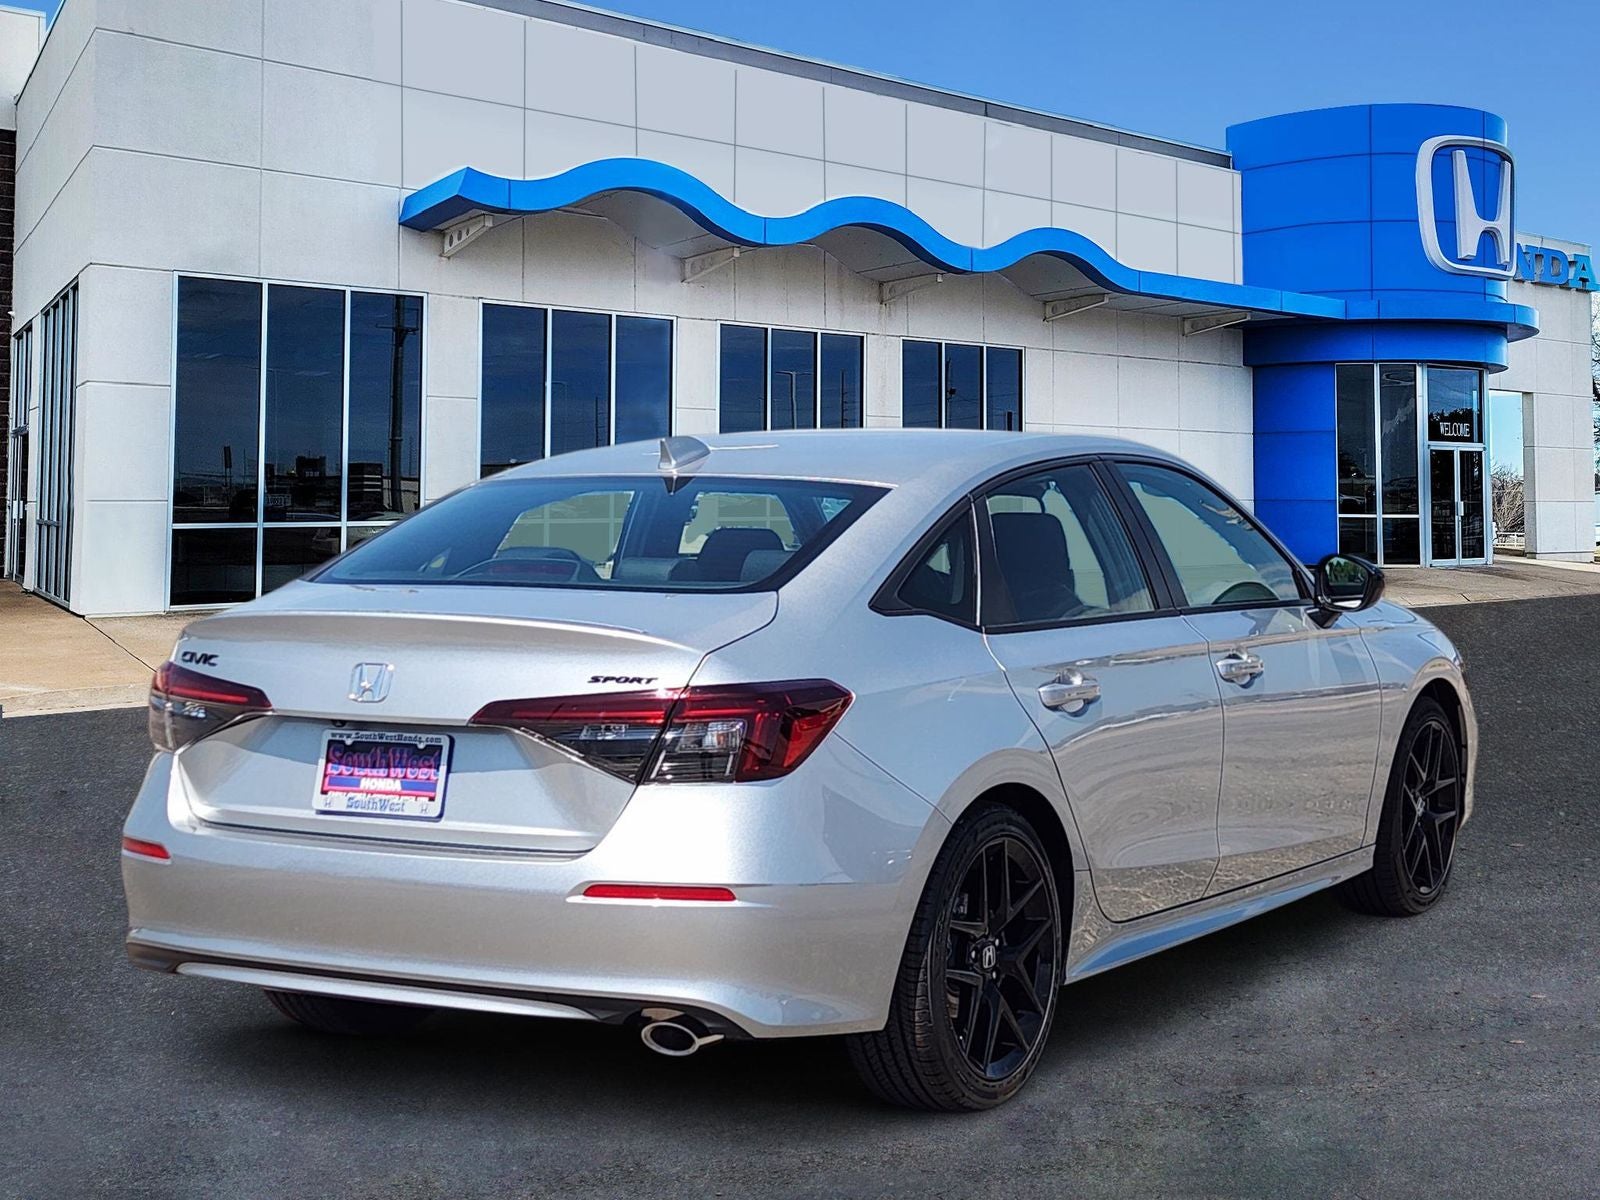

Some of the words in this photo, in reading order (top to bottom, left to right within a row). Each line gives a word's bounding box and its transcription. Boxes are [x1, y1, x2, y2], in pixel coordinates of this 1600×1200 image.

[1514, 243, 1600, 292] NDA
[1439, 422, 1471, 437] WELCOME
[181, 650, 219, 667] CIVIC
[587, 675, 659, 685] SPORT
[359, 777, 402, 791] HONDA
